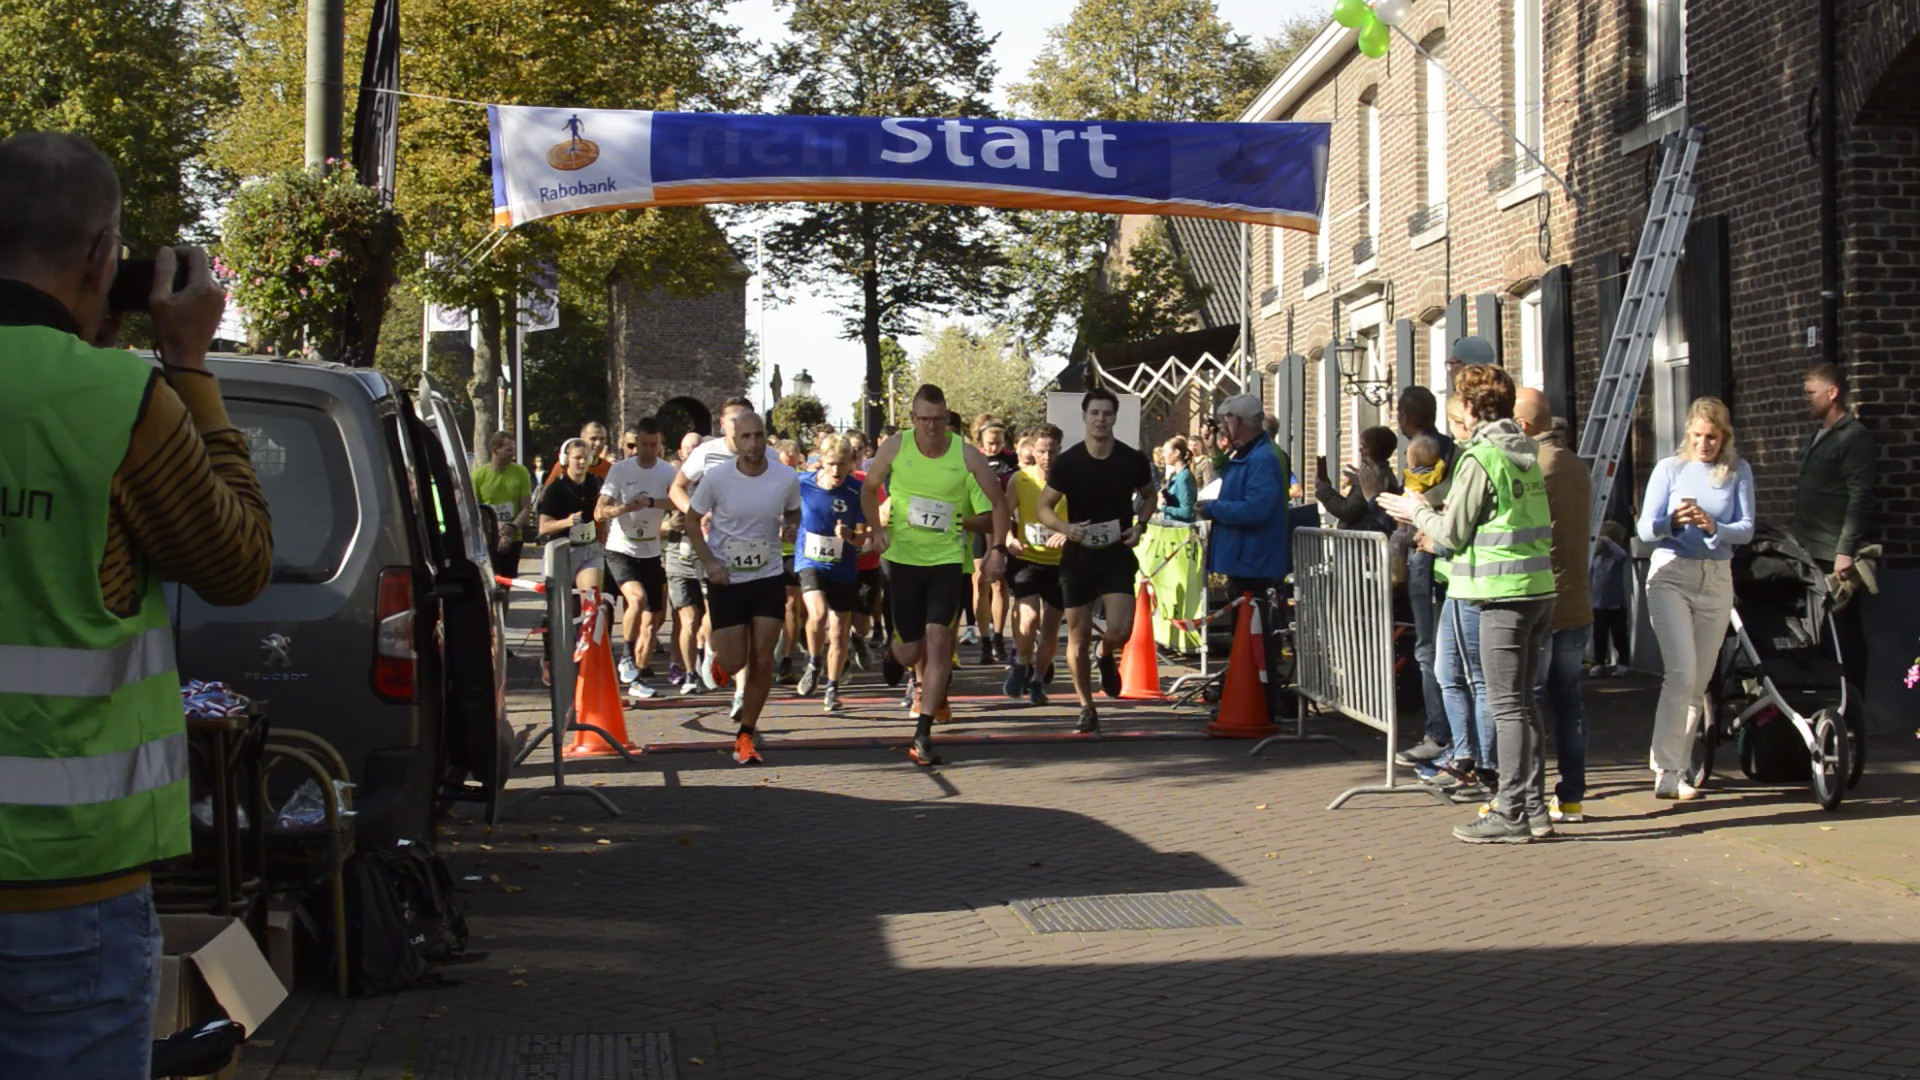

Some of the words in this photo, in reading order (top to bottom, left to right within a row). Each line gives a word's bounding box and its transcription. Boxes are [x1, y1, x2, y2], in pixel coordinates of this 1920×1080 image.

[880, 116, 1117, 179] Start
[540, 177, 617, 203] Rabobank
[921, 513, 940, 526] 17
[636, 528, 644, 538] 9
[1091, 533, 1109, 545] 53
[734, 553, 761, 567] 141
